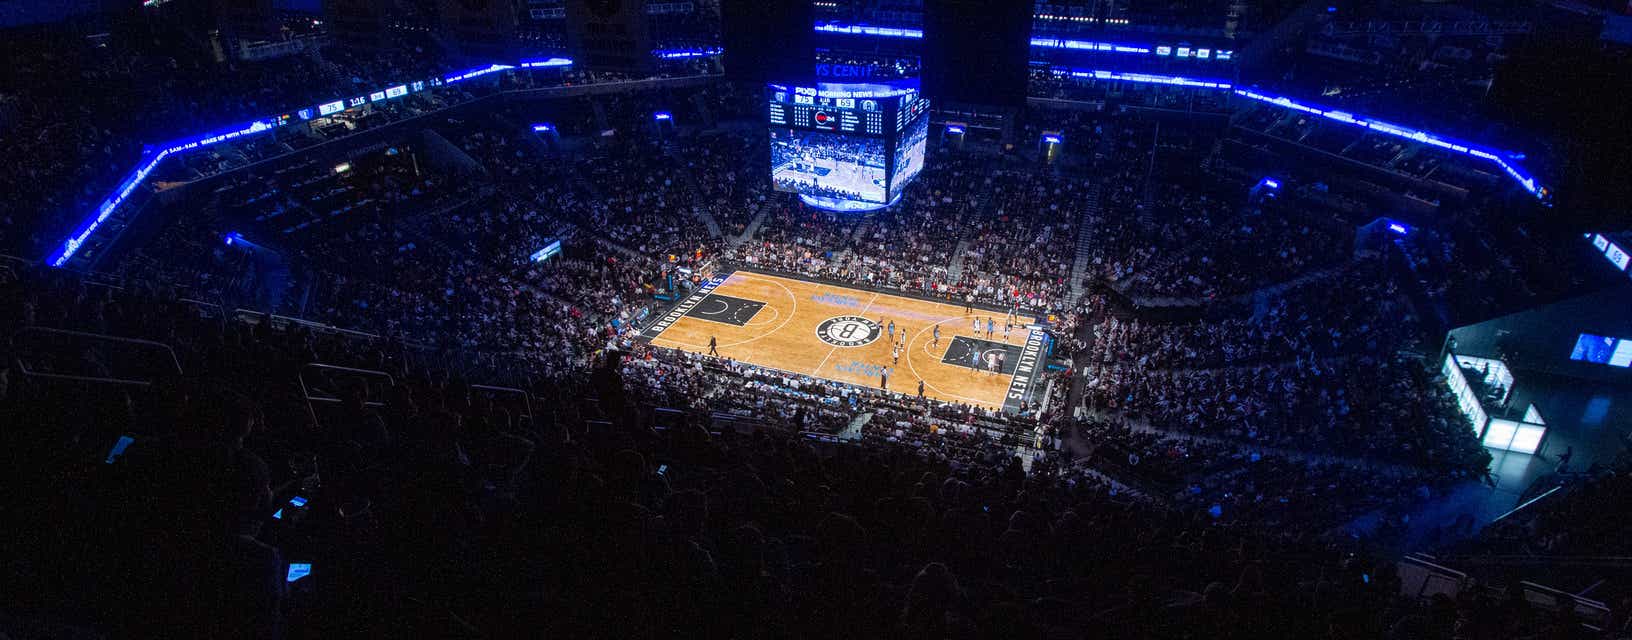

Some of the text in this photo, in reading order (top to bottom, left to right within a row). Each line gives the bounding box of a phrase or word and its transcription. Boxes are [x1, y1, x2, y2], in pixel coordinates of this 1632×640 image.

[349, 96, 366, 107] 1:16
[818, 90, 851, 98] MORNING
[698, 277, 723, 294] NETS
[651, 295, 702, 332] BROOKLYN
[838, 323, 859, 339] B
[1008, 330, 1043, 399] BROOKLYN NETS
